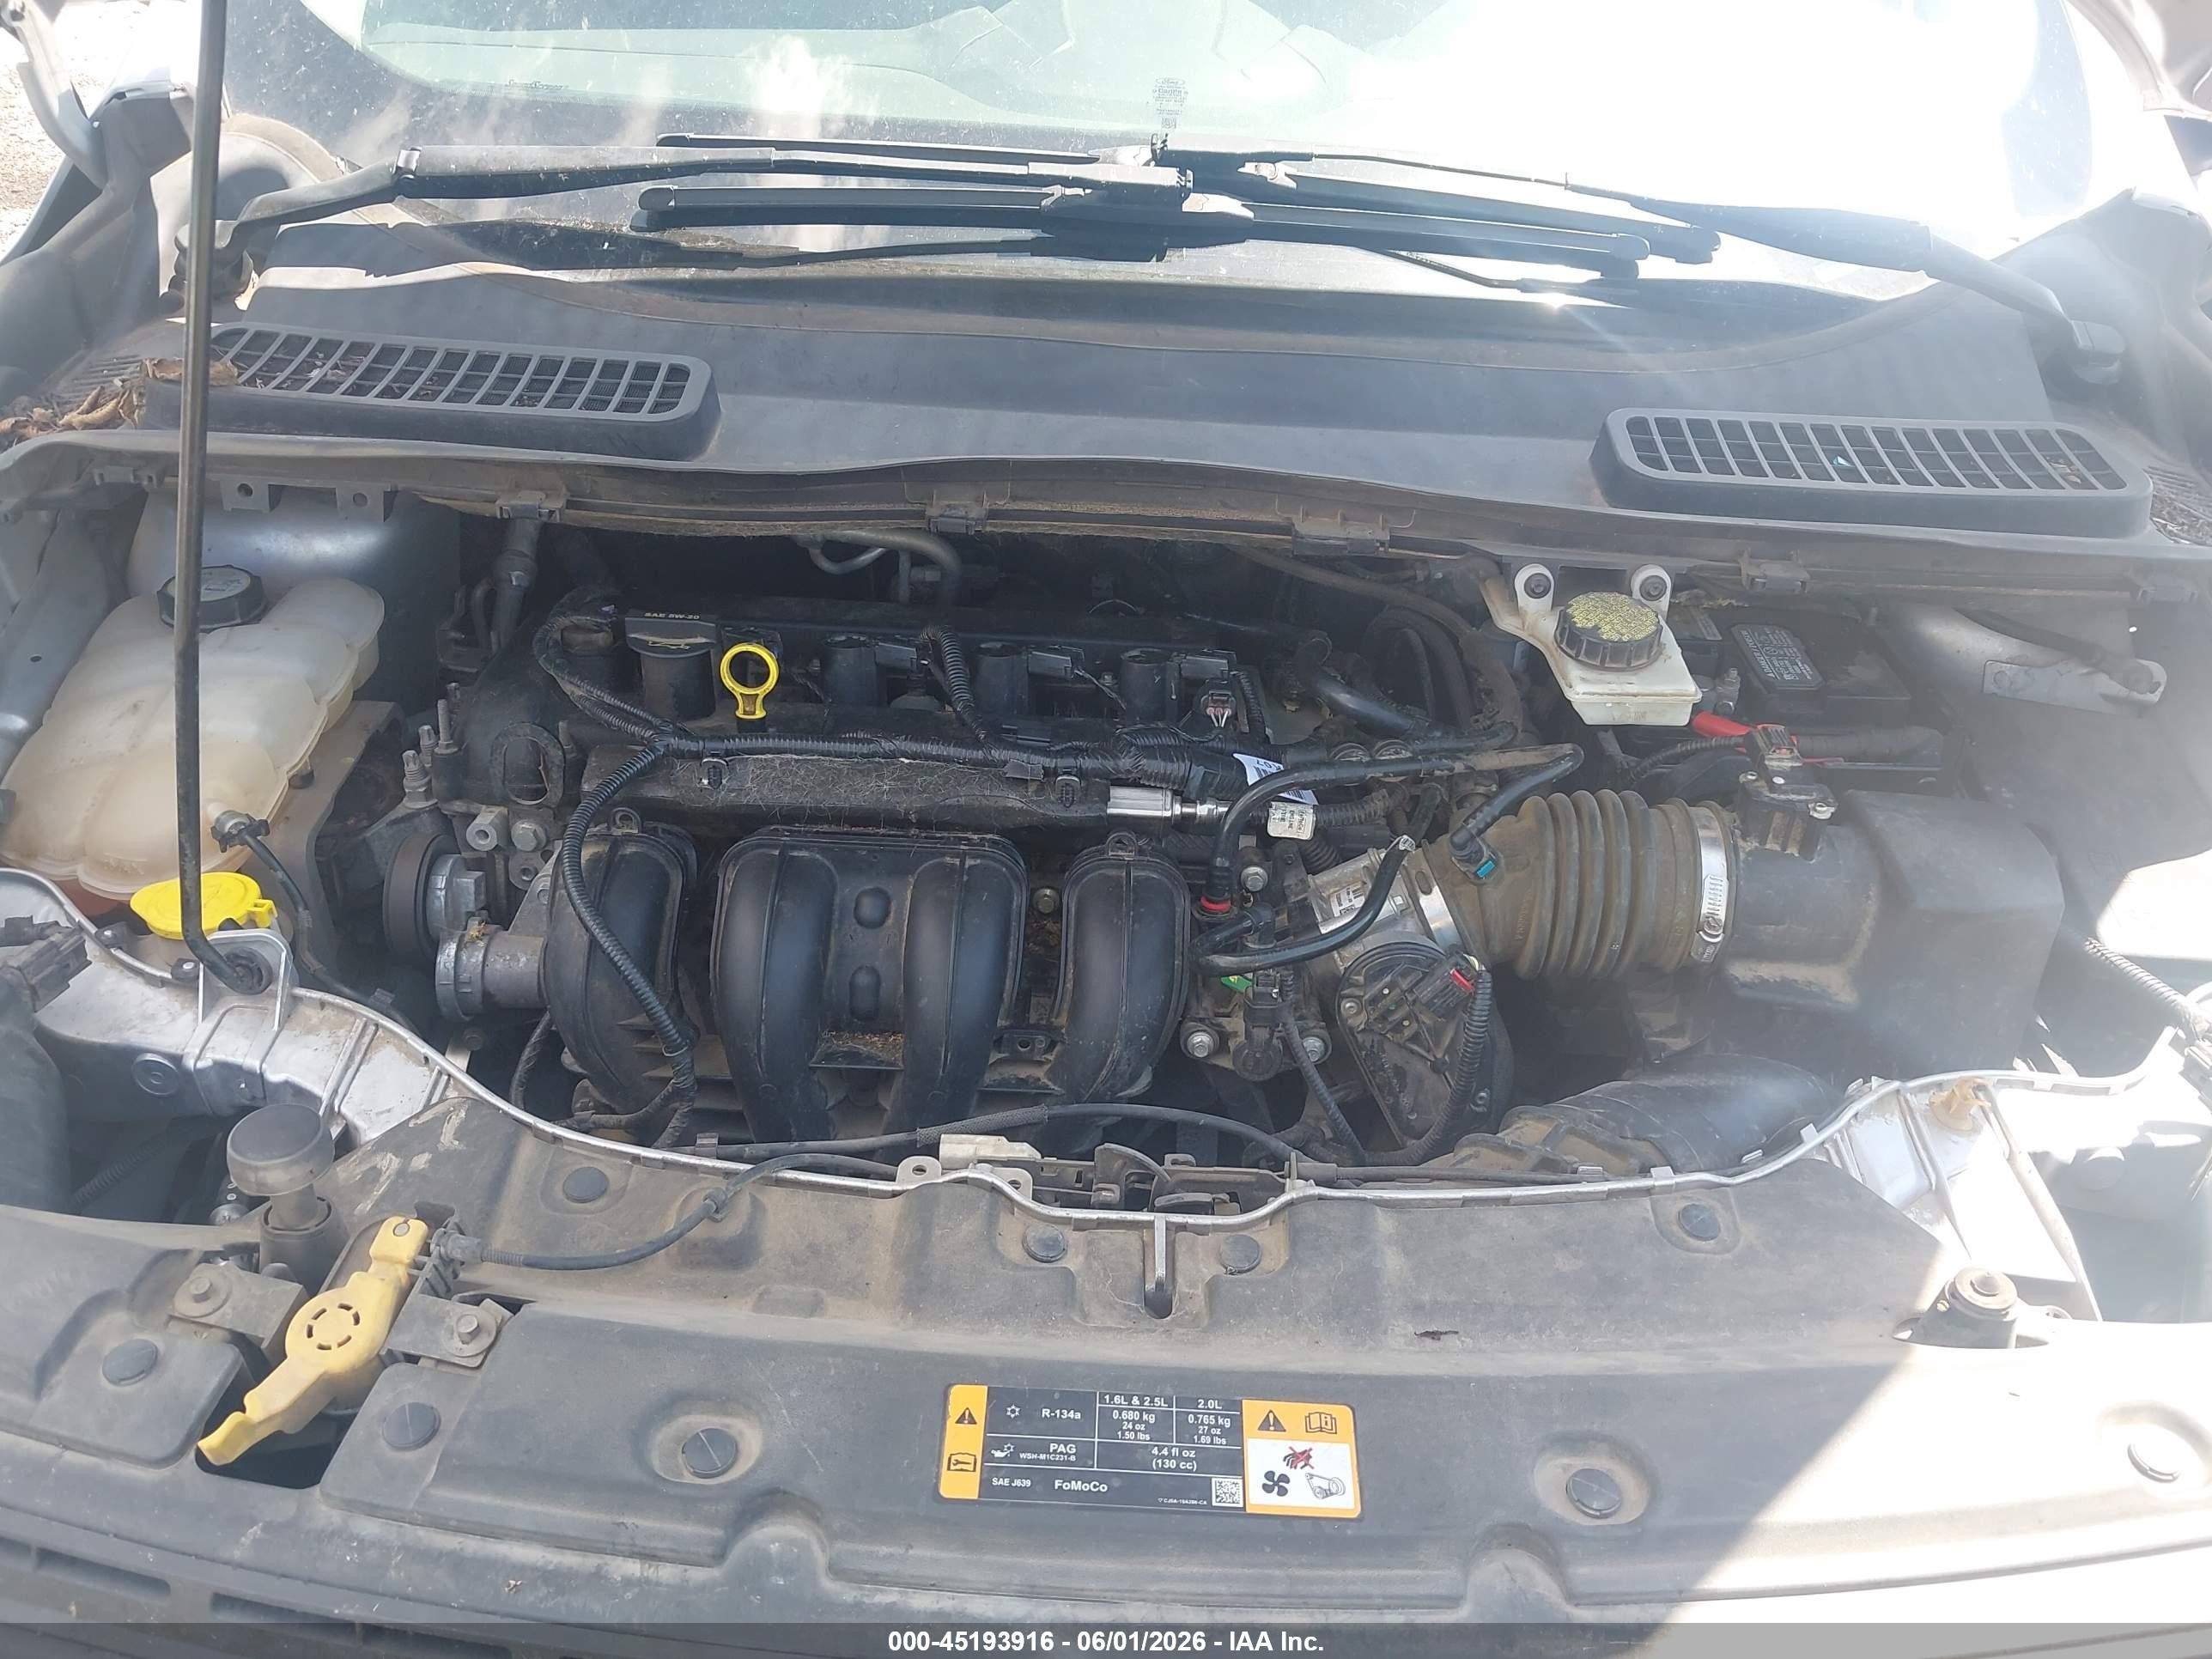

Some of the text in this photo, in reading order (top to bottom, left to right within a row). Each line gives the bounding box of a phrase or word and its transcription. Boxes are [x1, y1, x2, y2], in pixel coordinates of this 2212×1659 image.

[1103, 1395, 1169, 1407] 1.6L & 2.5L
[1197, 1399, 1223, 1409] 2.0L
[1042, 1407, 1081, 1419] R-134a
[1112, 1410, 1156, 1424] 0.680 kg
[1188, 1414, 1231, 1428] 0.765 kg
[1117, 1431, 1151, 1441] 1.50 lbs
[1194, 1435, 1226, 1445] 1.69 lbs
[1049, 1443, 1076, 1454] PAG
[1152, 1446, 1196, 1458] 4.4 fl oz
[1019, 1452, 1076, 1462] WSH-M1C231-B
[1152, 1459, 1197, 1472] (130 cc)
[992, 1478, 1031, 1487] SAE J639
[1054, 1480, 1108, 1492] FoMoCo
